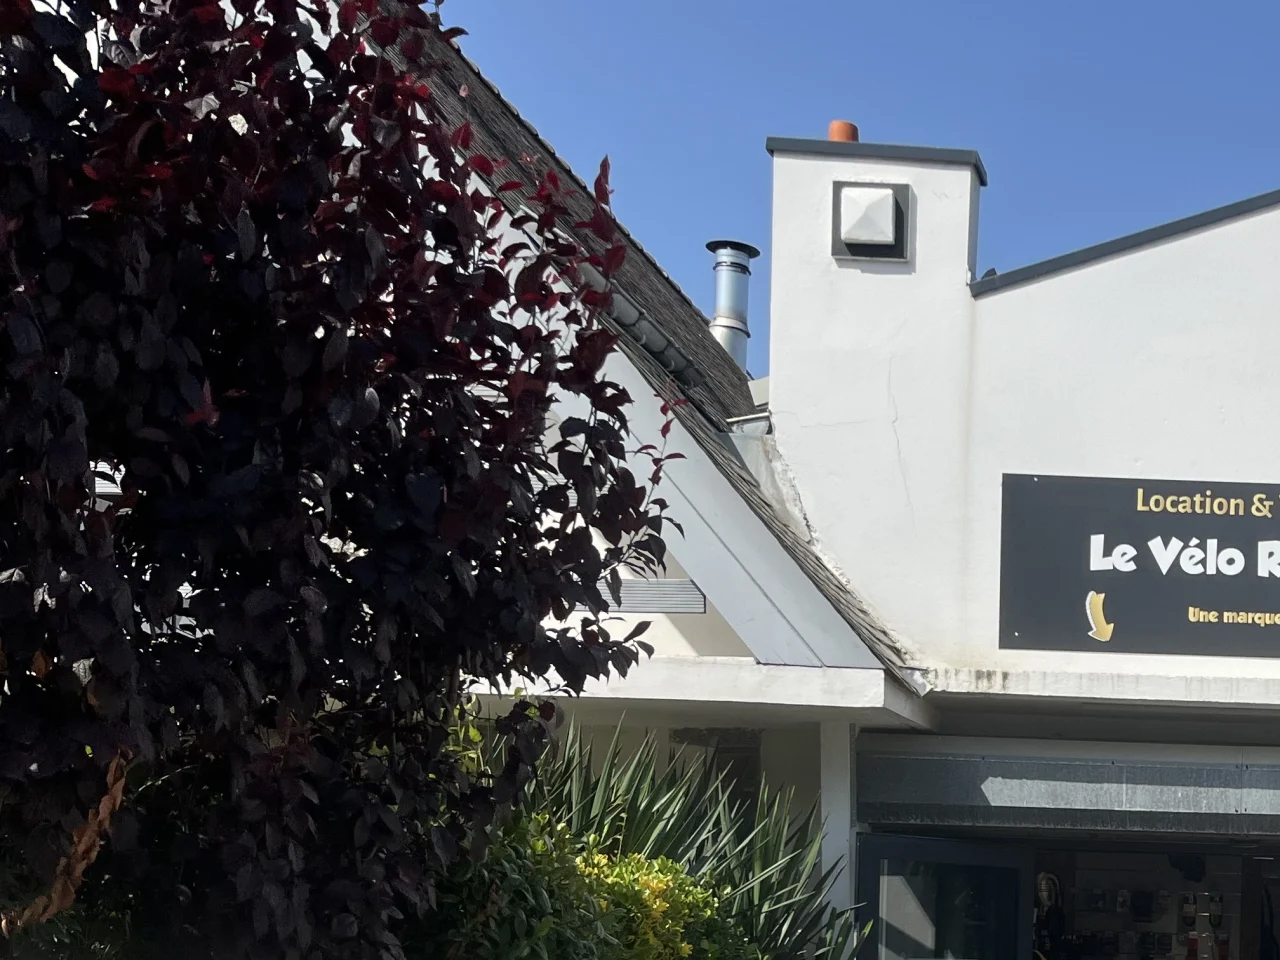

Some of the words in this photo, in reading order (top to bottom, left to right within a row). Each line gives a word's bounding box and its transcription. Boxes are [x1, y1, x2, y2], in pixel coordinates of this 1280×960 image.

[1136, 488, 1245, 516] Location
[1251, 493, 1274, 518] &
[1089, 534, 1138, 572] Le
[1147, 536, 1245, 576] Vélo
[1188, 606, 1219, 623] Une
